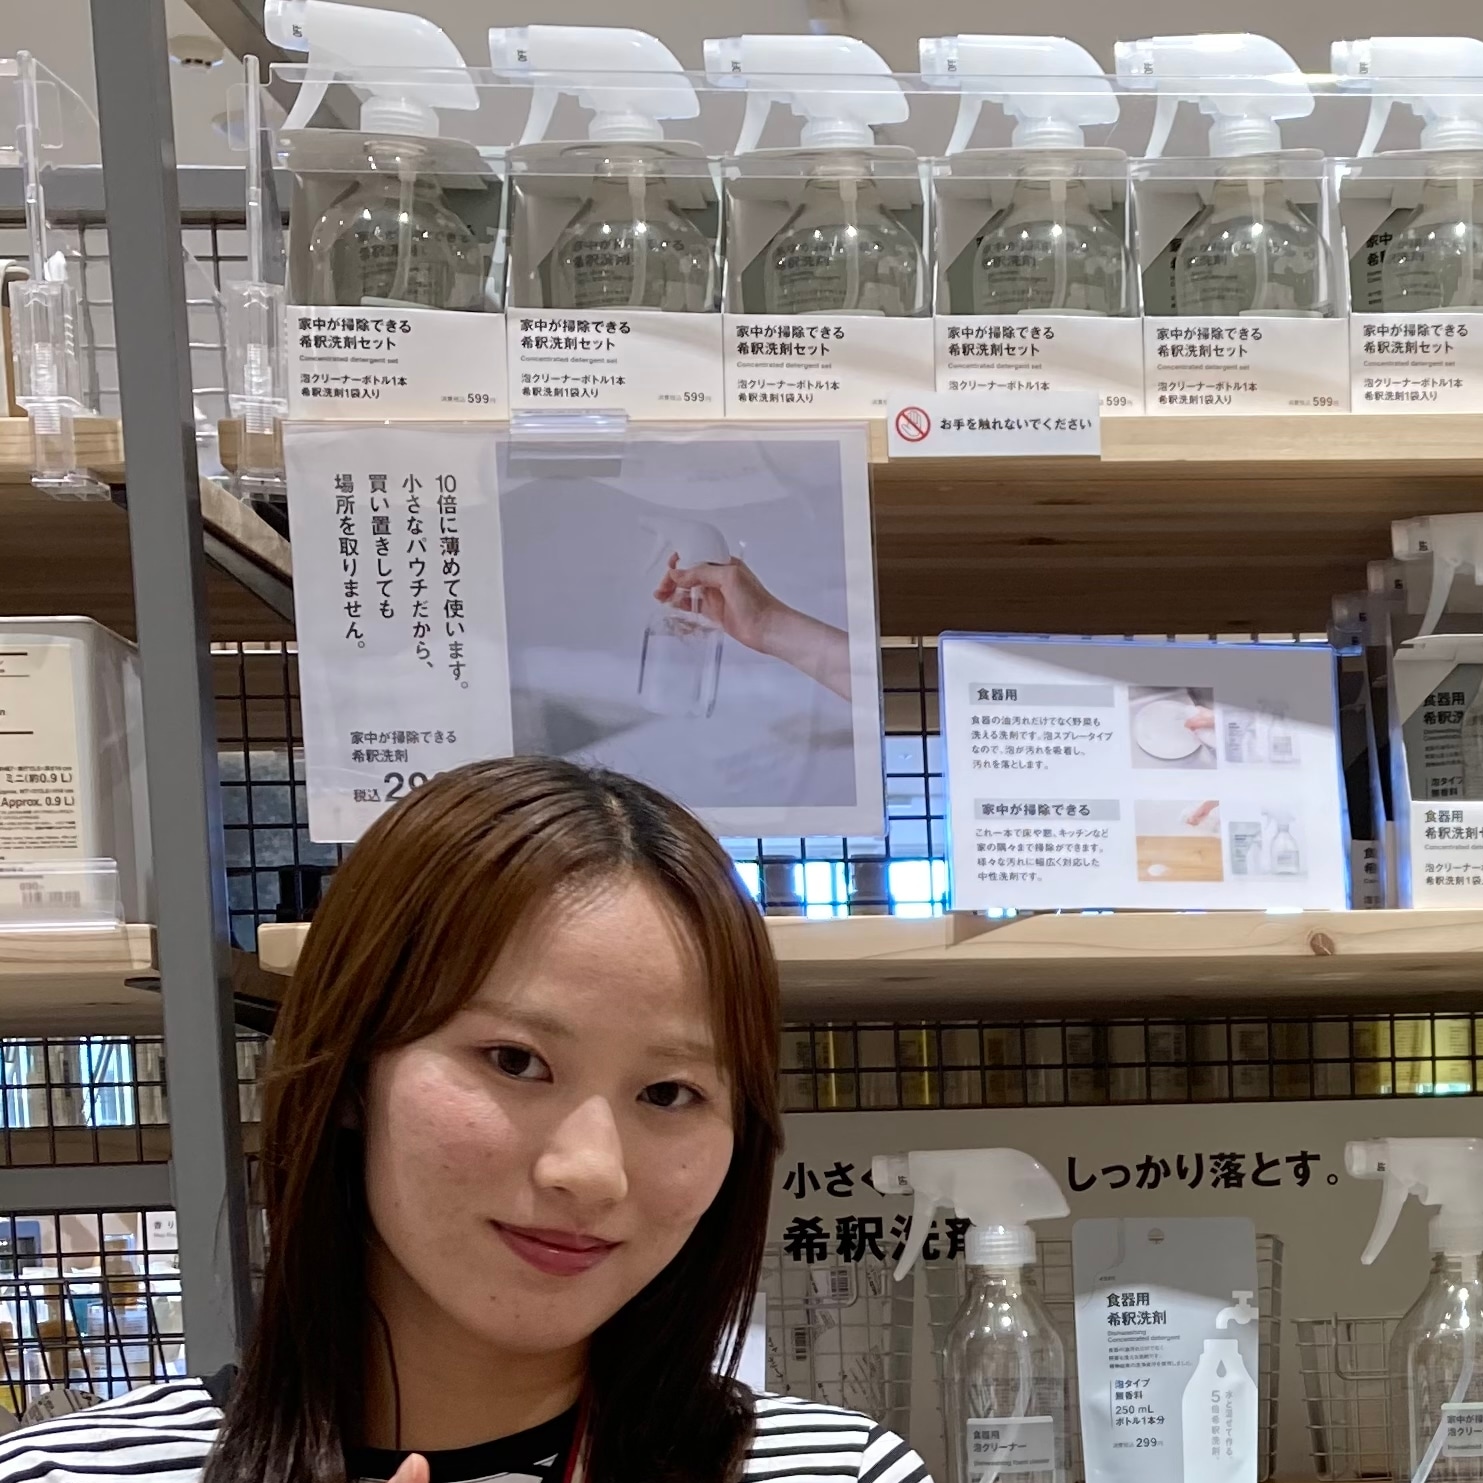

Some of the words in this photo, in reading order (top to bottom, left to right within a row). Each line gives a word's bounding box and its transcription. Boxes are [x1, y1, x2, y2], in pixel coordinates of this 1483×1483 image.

[299, 318, 411, 334] 家中が掃除できる
[520, 319, 631, 333] 家中が掃除できる
[736, 325, 845, 339] 家中が掃除できる
[948, 325, 1054, 339] 家中が掃除できる
[1363, 324, 1468, 338] 家中が掃除できる
[1157, 327, 1262, 341] 家中が掃除できる
[299, 335, 396, 350] 希釈洗剤セット
[737, 341, 830, 356] 希釈洗剤セット
[1363, 340, 1453, 354] 希釈洗剤セット
[1157, 344, 1248, 357] 希釈洗剤セット
[940, 417, 1092, 431] お手を触れないでください
[369, 474, 396, 619] 買い置きしても
[335, 474, 365, 649] 場所を取りません。
[402, 474, 434, 671] 小さなパウチだから、
[435, 474, 469, 689] 10倍に薄めて使います。
[977, 688, 1018, 702] 食器用
[350, 730, 457, 745] 家中が掃除できる
[351, 749, 409, 764] 希釈洗剤
[982, 804, 1090, 817] 家中が掃除できる
[1425, 810, 1463, 823] 食器用
[1067, 1150, 1339, 1190] しっかり落とす。
[1106, 1292, 1150, 1307] 食器用
[1107, 1310, 1166, 1326] 希釈洗剤
[1115, 1378, 1150, 1389] 泡タイプ
[1115, 1404, 1135, 1414] 250
[1137, 1404, 1154, 1414] mL
[1116, 1415, 1165, 1426] ボトル1本分
